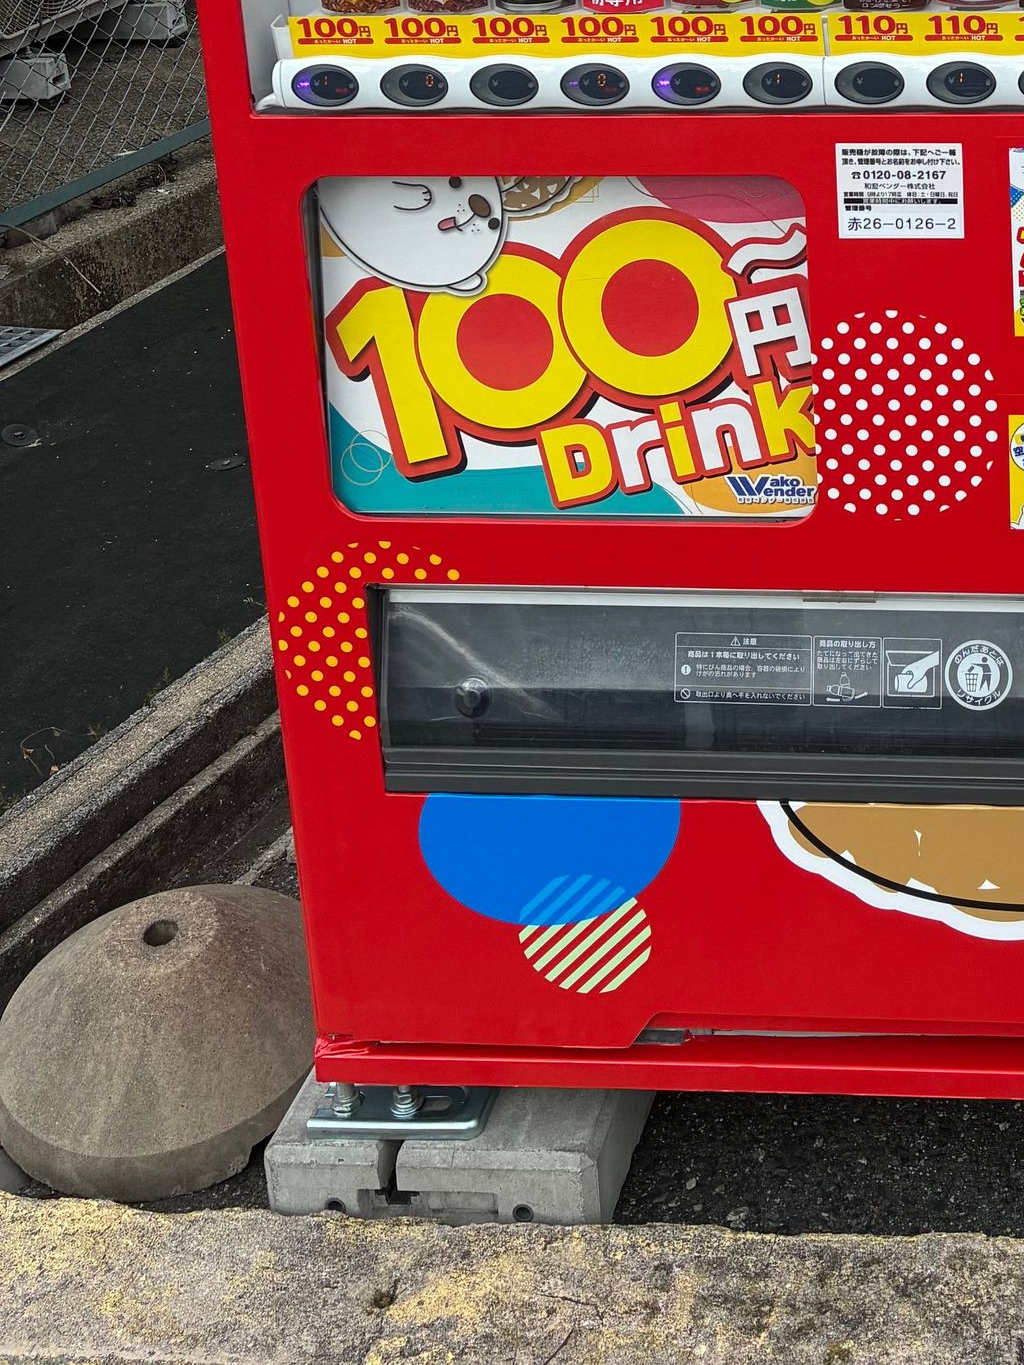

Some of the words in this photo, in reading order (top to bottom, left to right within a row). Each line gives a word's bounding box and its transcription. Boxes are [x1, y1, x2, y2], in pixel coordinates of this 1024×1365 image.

[296, 18, 372, 38] 100円
[383, 17, 460, 38] 100円
[471, 17, 548, 37] 100円
[560, 16, 636, 36] 100円
[650, 16, 726, 36] 100円
[739, 15, 816, 35] 100円
[838, 15, 908, 35] 110円
[928, 15, 998, 35] 110円
[862, 170, 947, 180] 0120-08-2167
[864, 182, 936, 190] 和宏ベンダー株式会社
[540, 380, 816, 503] Drink
[818, 639, 876, 649] 商品の取り出し方
[953, 643, 1006, 666] のんだあとは
[955, 689, 1002, 706] リサイクル
